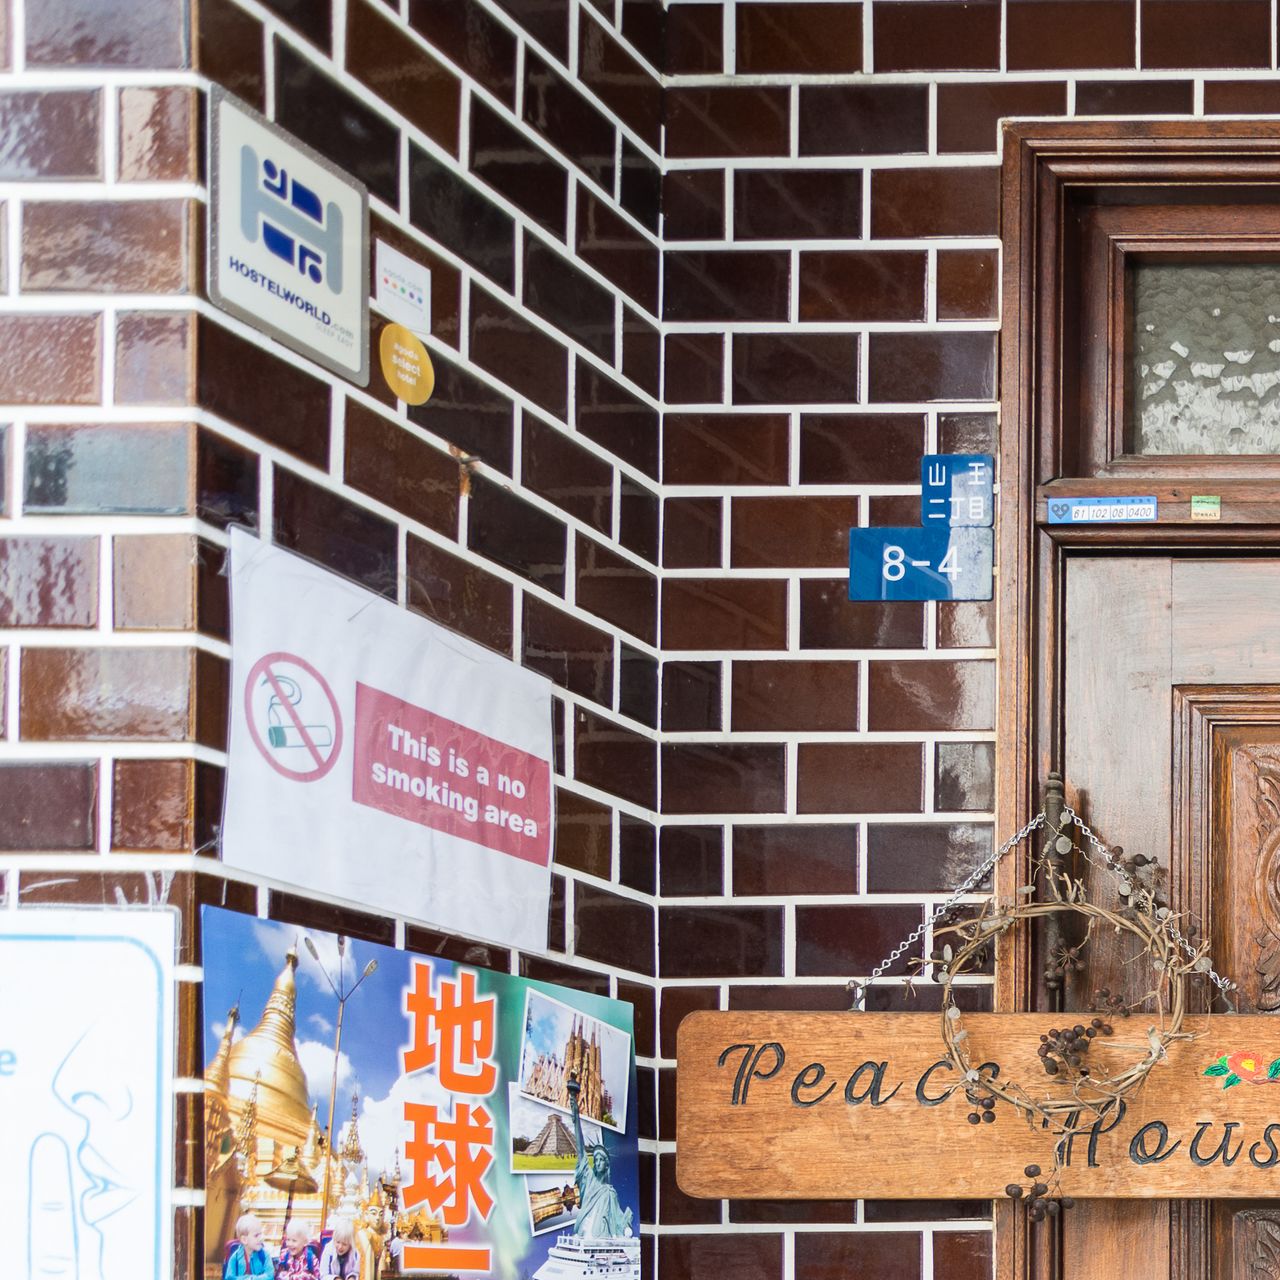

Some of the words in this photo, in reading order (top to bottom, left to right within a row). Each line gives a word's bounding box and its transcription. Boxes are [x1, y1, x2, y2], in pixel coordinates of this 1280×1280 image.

[392, 354, 422, 377] select
[397, 370, 417, 385] hotel
[928, 496, 984, 519] 二丁目
[1073, 509, 1086, 519] 61
[1090, 508, 1107, 519] 102
[1112, 508, 1124, 518] 08
[1128, 507, 1152, 518] 0400
[882, 545, 963, 582] 8-4
[388, 724, 441, 767] This
[448, 748, 470, 777] is
[476, 765, 490, 787] a
[498, 773, 526, 799] no
[371, 762, 479, 823] smoking
[484, 804, 538, 838] area
[718, 1041, 1002, 1108] Peace
